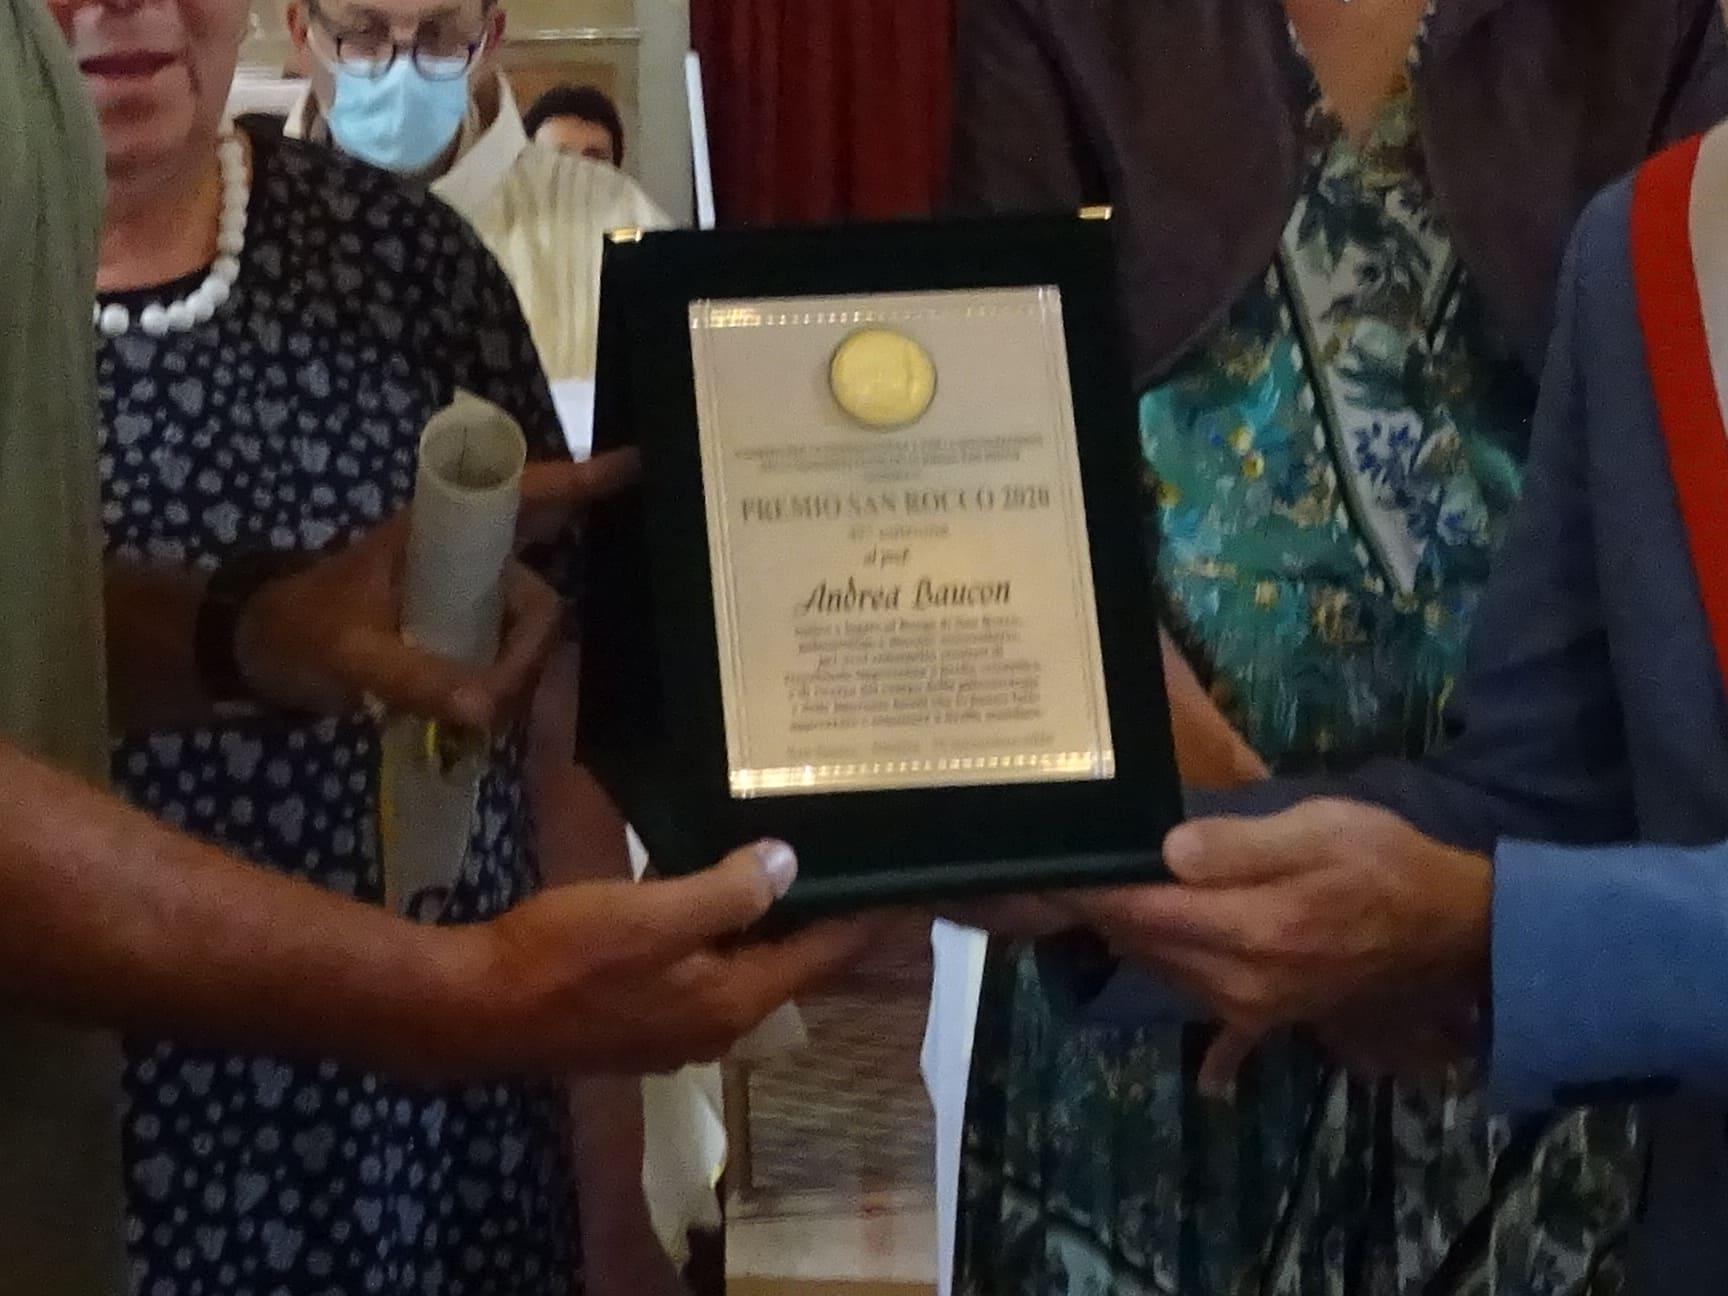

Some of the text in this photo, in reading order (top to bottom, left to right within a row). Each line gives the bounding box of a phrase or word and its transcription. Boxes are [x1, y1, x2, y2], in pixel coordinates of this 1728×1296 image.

[741, 492, 843, 521] PREMIO
[904, 485, 995, 515] ROCCO
[797, 575, 1012, 614] Andrea Baucon
